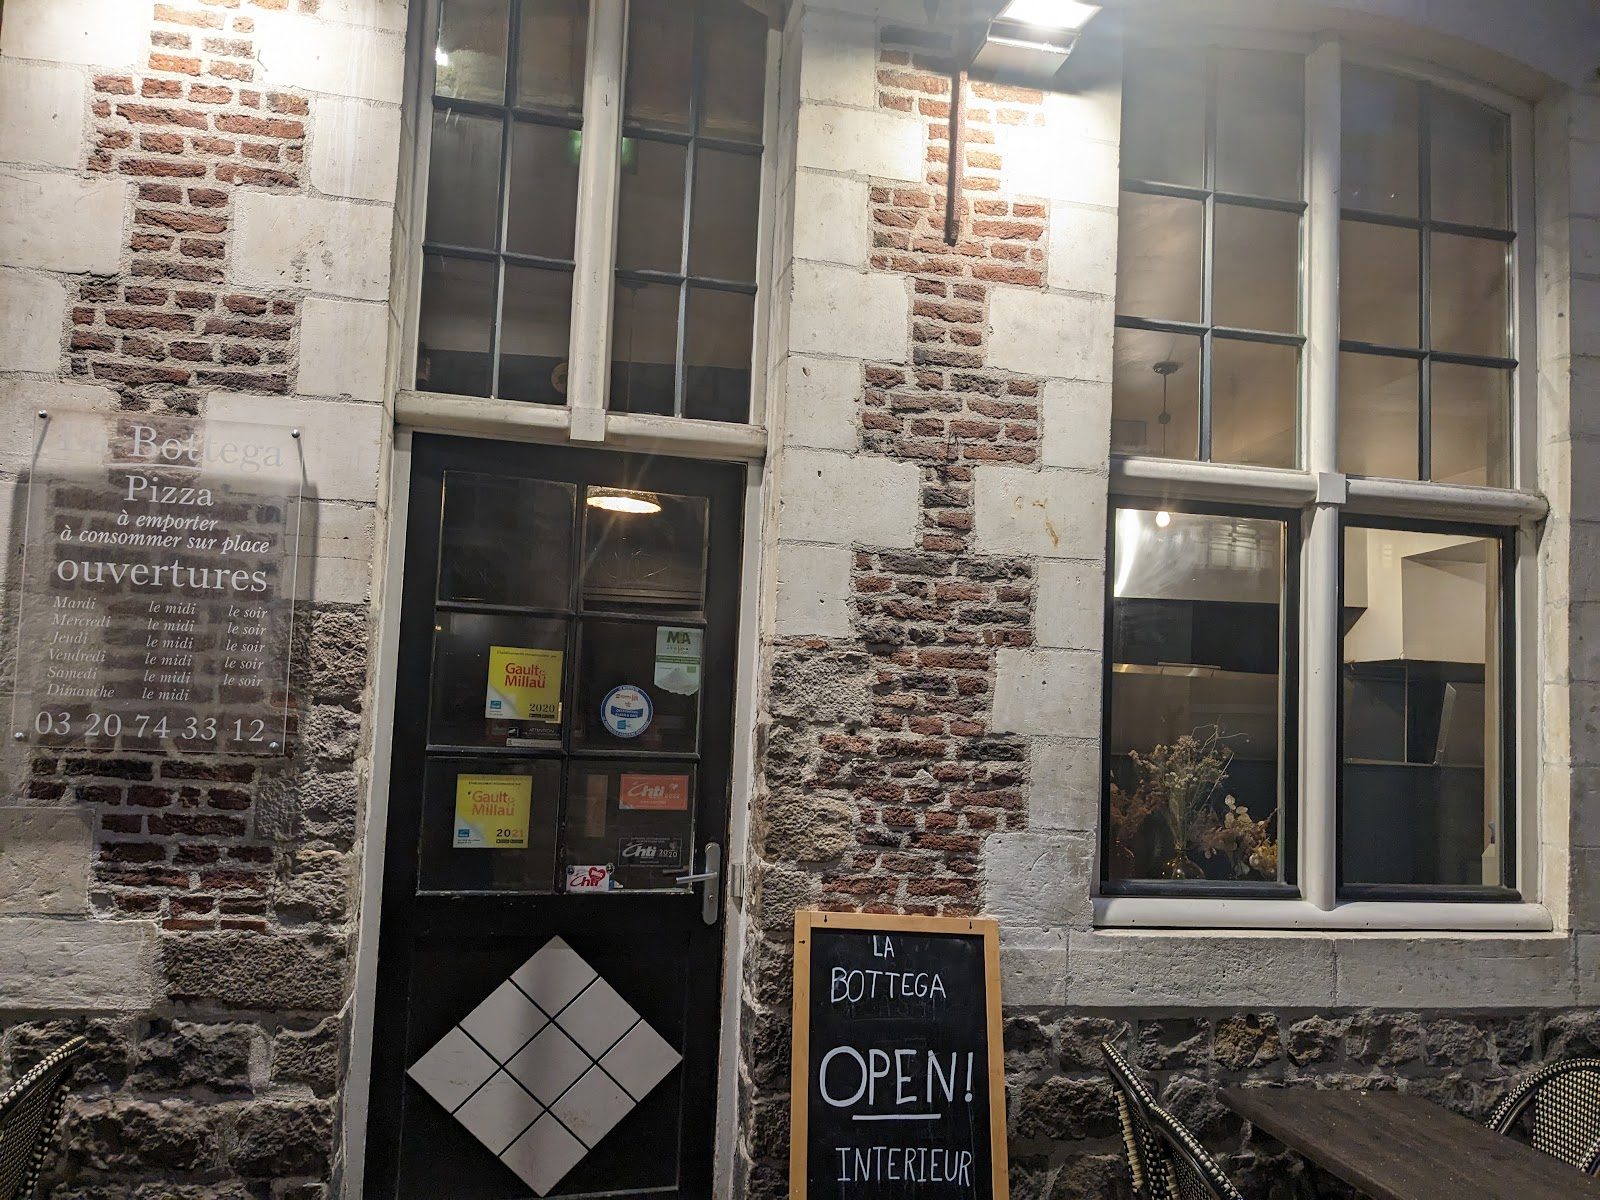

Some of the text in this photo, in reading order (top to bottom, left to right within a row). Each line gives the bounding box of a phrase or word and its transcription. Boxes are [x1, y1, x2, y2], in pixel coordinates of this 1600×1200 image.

[130, 425, 284, 474] Bottega
[124, 475, 214, 507] Pizza
[117, 509, 219, 532] à emporter
[60, 524, 270, 555] à consommer sur place
[57, 558, 268, 592] ouvertures
[52, 596, 269, 619] Mardi le midi le soir
[52, 614, 267, 636] Mercredi le midi le soir
[49, 631, 266, 653] Jeudi le midi le soir
[48, 649, 264, 671] Vendredi le midi le soir
[47, 666, 263, 688] Samedi le midi le soir
[505, 675, 546, 689] Millau
[47, 683, 190, 701] Dimanche le midi
[529, 703, 555, 713] 2020
[35, 711, 265, 742] 03 20 74 33 12
[471, 803, 515, 817] Millau
[873, 935, 895, 958] LA
[831, 967, 946, 1003] BOTTEGA
[819, 1046, 974, 1107] OPEN!
[835, 1146, 972, 1187] INTERIEUR
